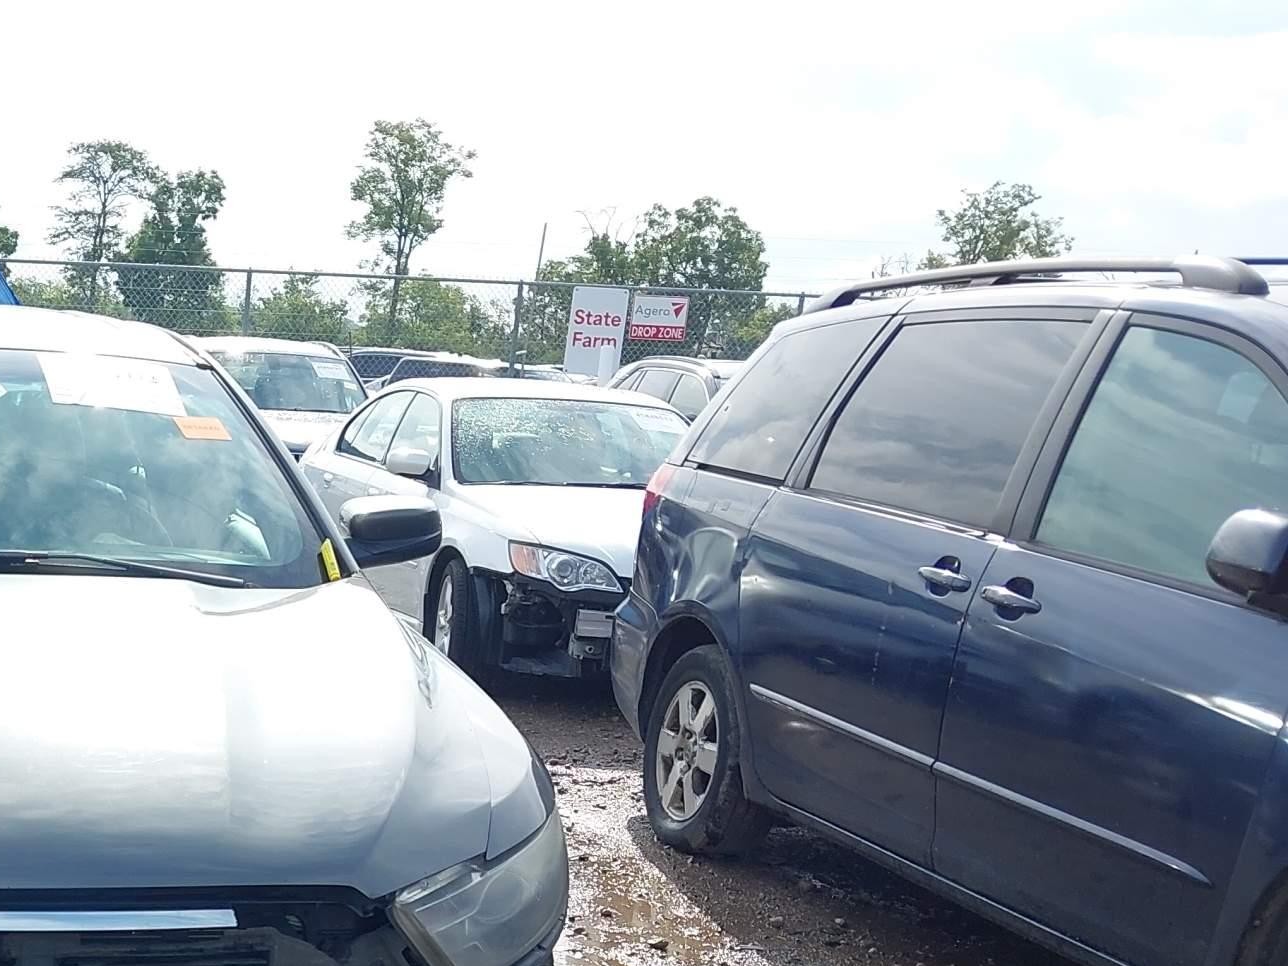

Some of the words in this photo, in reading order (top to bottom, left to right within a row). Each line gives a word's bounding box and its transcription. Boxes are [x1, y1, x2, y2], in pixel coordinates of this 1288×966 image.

[574, 309, 622, 327] State
[635, 305, 671, 318] Agero
[572, 332, 617, 349] Farm
[631, 327, 657, 337] DROP
[658, 328, 684, 339] ZONE
